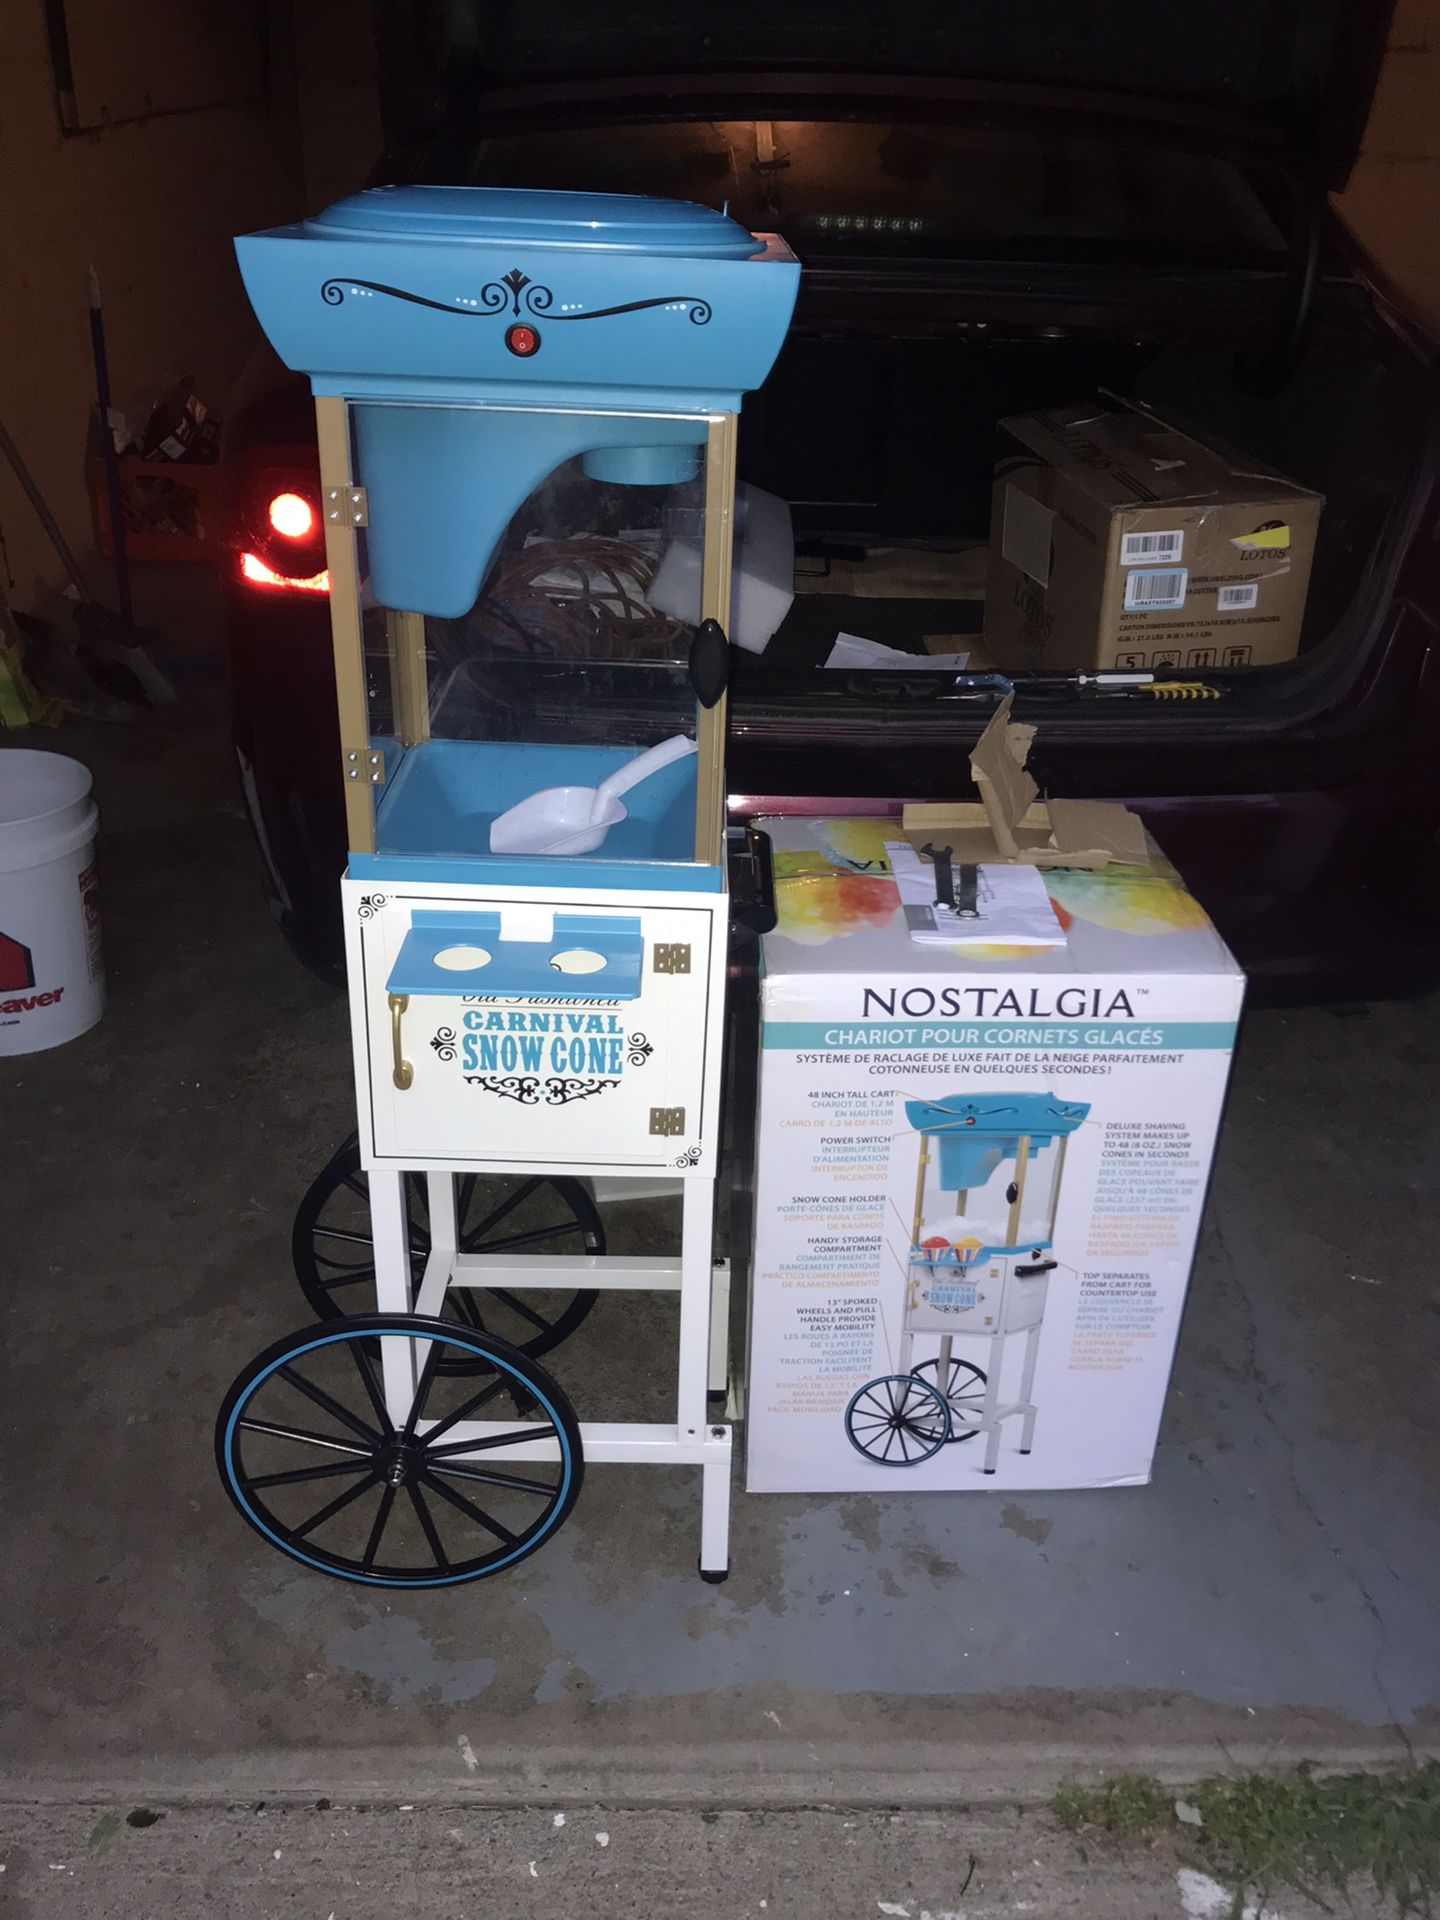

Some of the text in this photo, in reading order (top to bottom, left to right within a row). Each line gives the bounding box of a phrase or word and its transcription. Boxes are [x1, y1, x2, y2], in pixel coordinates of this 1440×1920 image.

[1240, 549, 1286, 561] LOTOS
[0, 987, 64, 1013] aver
[862, 988, 1135, 1017] NOSTALGIA
[462, 1010, 624, 1034] CARNIVAL
[825, 1027, 1164, 1045] CHARIOT POUR CORNETS GLACÉS
[462, 1033, 624, 1074] SNOW CONE
[854, 1054, 871, 1063] DE
[873, 1053, 929, 1062] RACLAGE
[932, 1053, 949, 1062] DE
[952, 1053, 982, 1062] LUXE
[985, 1053, 1011, 1062] FAIT
[1015, 1053, 1031, 1062] DE
[1034, 1053, 1050, 1062] LA
[1053, 1053, 1089, 1062] NEIGE
[1092, 1053, 1184, 1064] PARFAITEMENT
[869, 1065, 951, 1075] COTONNEUSE
[954, 1065, 969, 1074] EN
[973, 1064, 1038, 1075] QUELQUES
[870, 1090, 895, 1098] CART
[811, 1100, 852, 1108] CHARIOT
[855, 1100, 867, 1108] DE
[849, 1109, 893, 1117] HAUTEUR
[779, 1120, 811, 1128] CARRO
[1106, 1122, 1186, 1130] DELUXE SHAVING
[856, 1136, 891, 1144] SWITCH
[822, 1146, 890, 1154] INTERRUPTEUR
[833, 1173, 888, 1181] ENCENDIDO
[822, 1195, 847, 1203] CONE
[842, 1204, 854, 1212] DE
[783, 1214, 824, 1222] SOPORTE
[827, 1222, 883, 1230] DE RASPADO
[813, 1245, 881, 1253] COMPARTMENT
[796, 1253, 880, 1262] COMPARTIMENT DE
[779, 1263, 880, 1271] RANGEMENT PRATIQUE
[796, 1307, 831, 1315] WHEELS
[834, 1323, 875, 1331] MOBILITY
